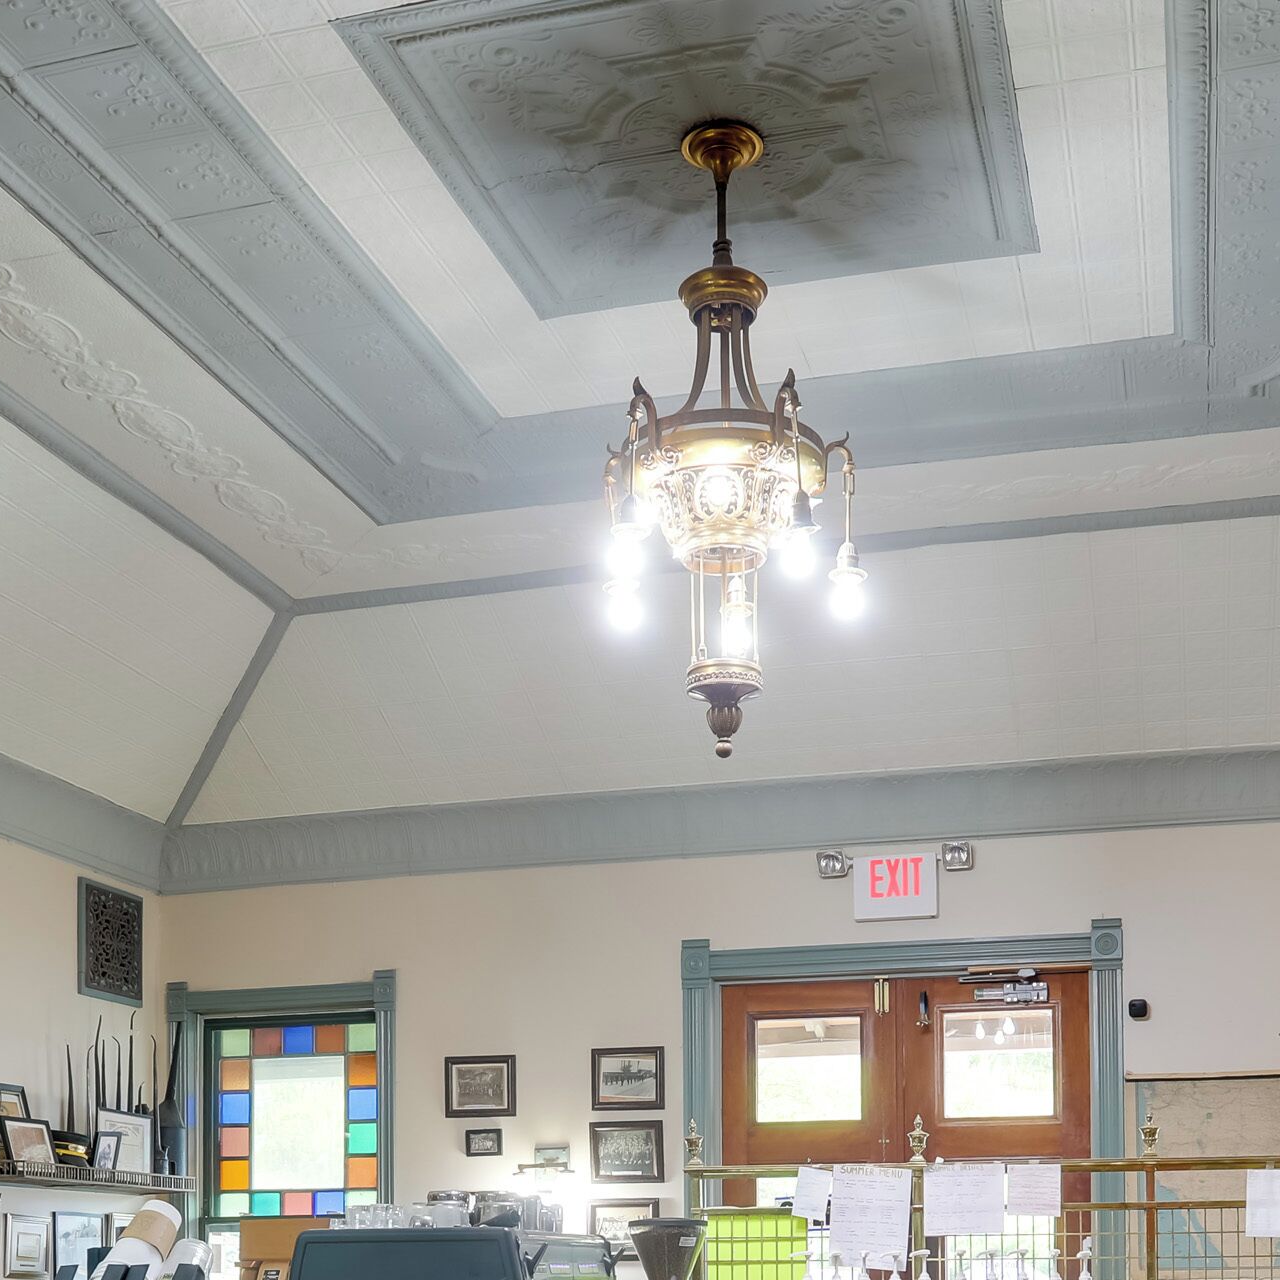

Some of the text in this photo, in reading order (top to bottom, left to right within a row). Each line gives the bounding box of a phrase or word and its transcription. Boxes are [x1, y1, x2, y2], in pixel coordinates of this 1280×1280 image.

[869, 857, 923, 899] EXIT
[840, 1165, 904, 1179] SUMMER MENU
